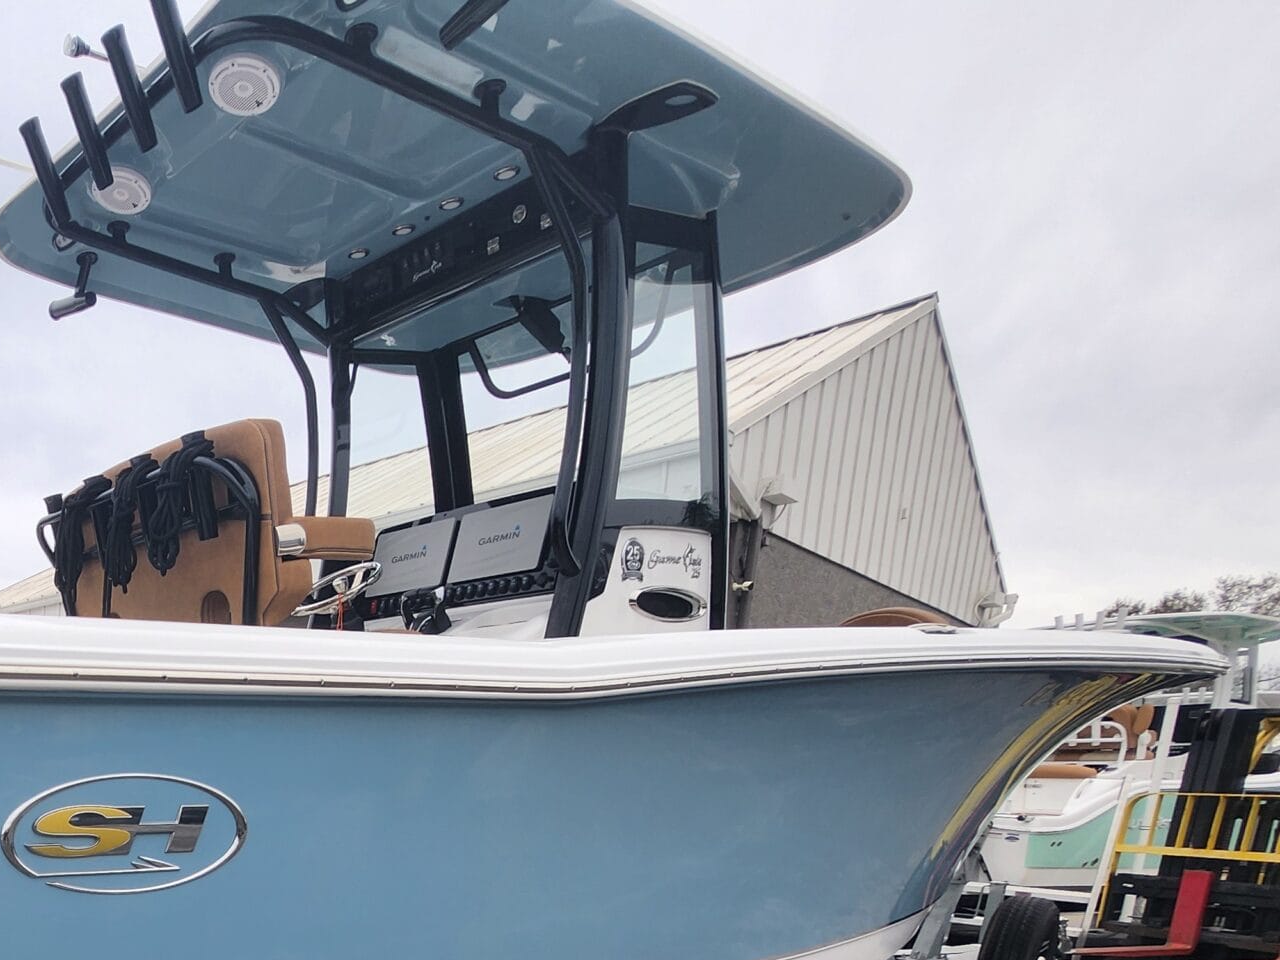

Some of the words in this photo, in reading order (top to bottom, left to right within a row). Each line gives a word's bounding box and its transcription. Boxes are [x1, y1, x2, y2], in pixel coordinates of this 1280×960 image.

[478, 530, 521, 546] GARMIN
[391, 549, 427, 564] GARMIN
[626, 544, 640, 561] 25
